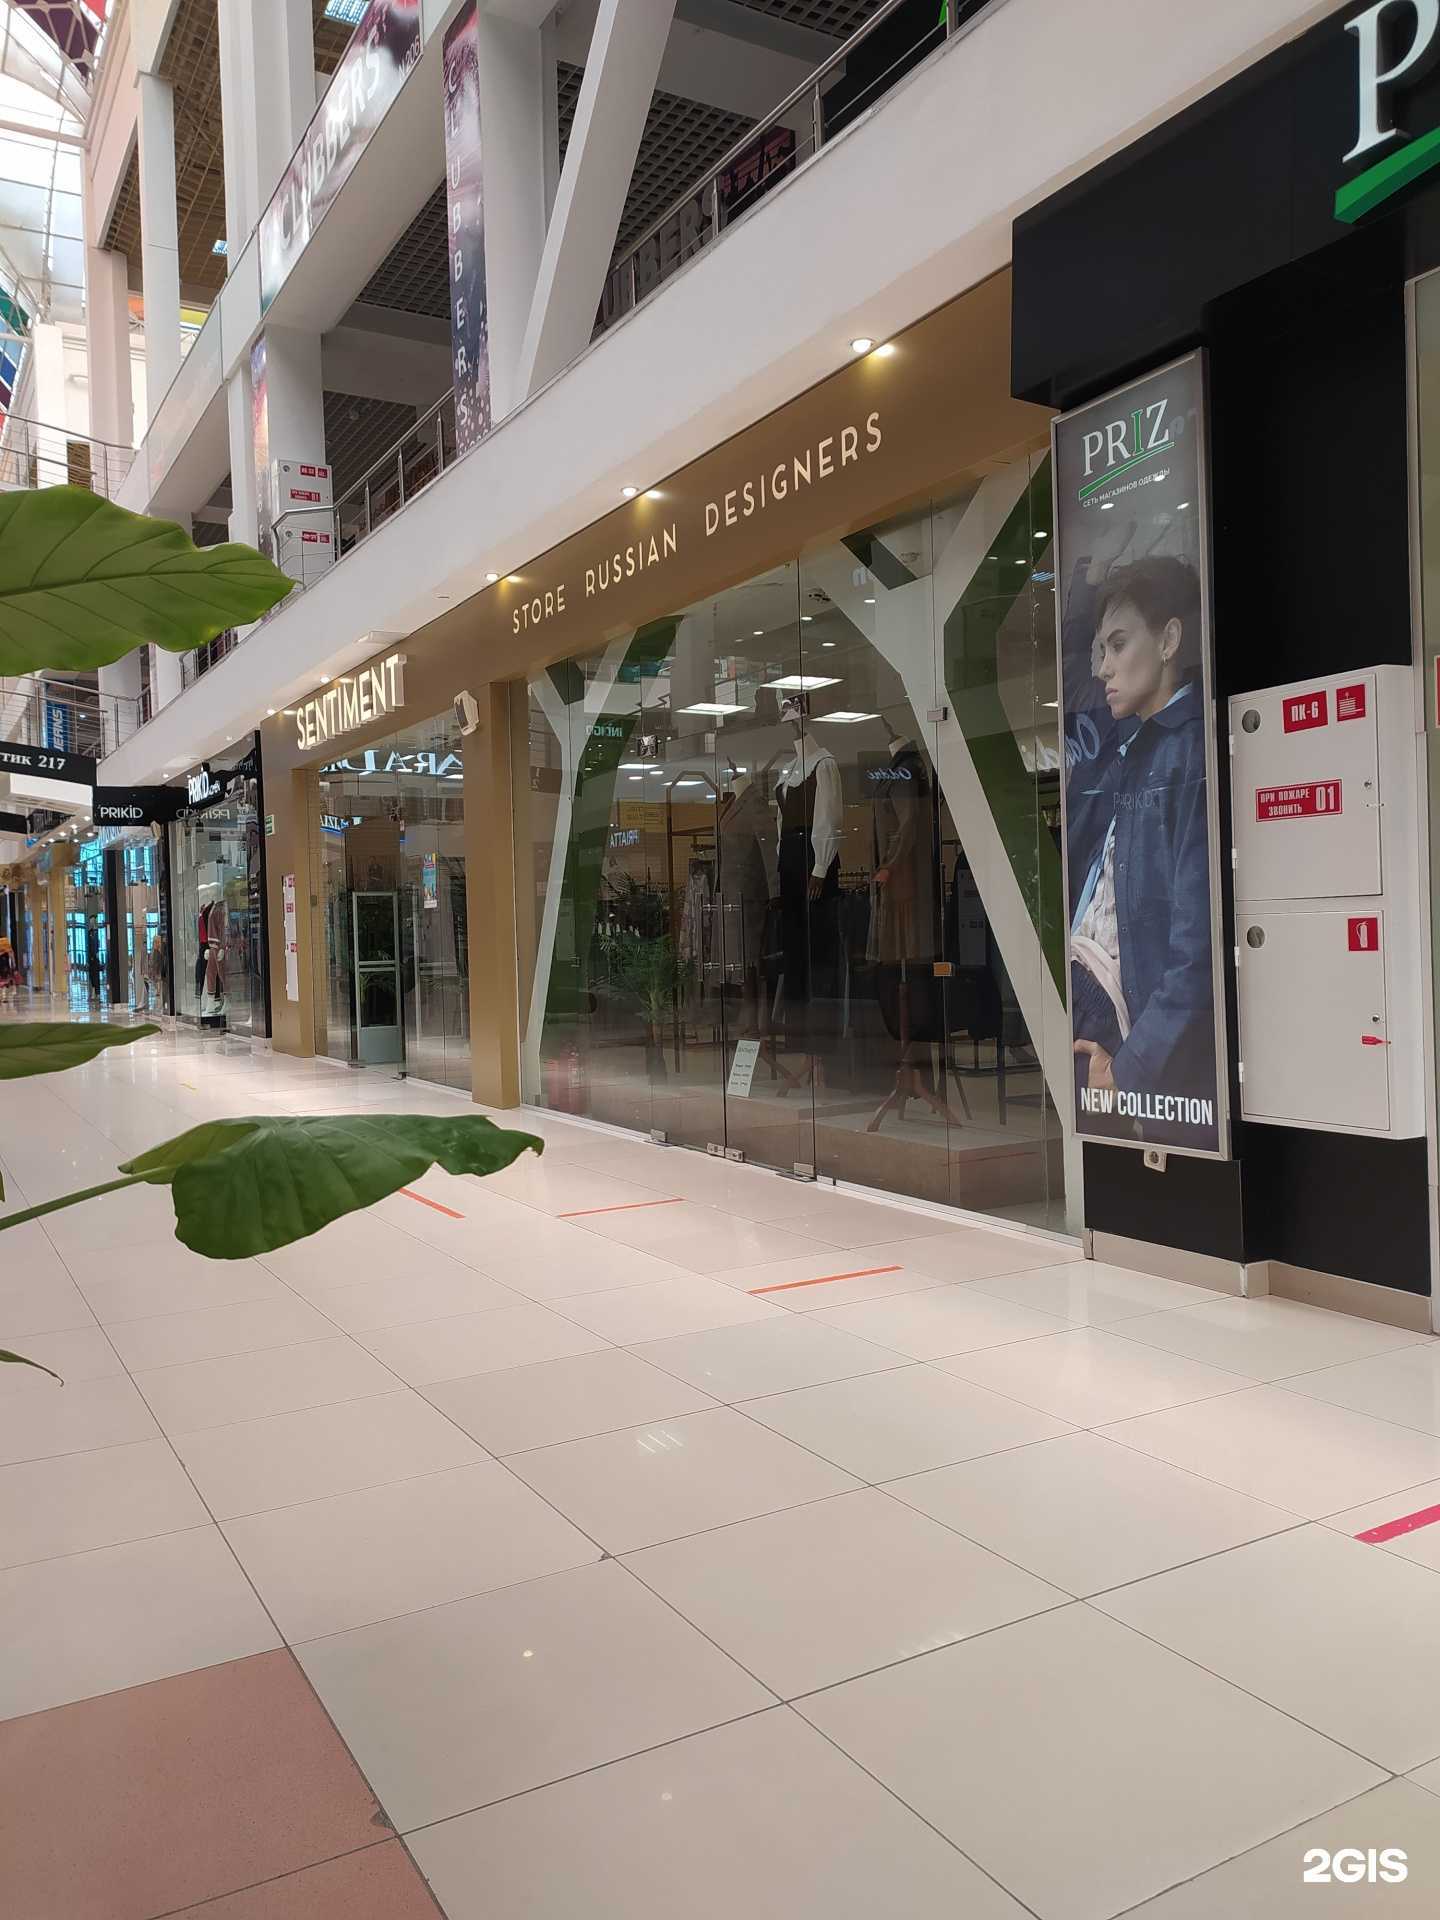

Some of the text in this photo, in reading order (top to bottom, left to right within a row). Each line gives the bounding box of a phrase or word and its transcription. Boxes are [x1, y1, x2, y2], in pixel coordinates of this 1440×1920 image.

[1344, 0, 1439, 162] P
[279, 24, 380, 250] CLUBBERS
[447, 62, 469, 425] CLUBBERS
[1082, 399, 1169, 476] PRIZ
[1083, 497, 1099, 507] СЕТЬ
[1099, 480, 1138, 500] МАГАЗИНОВ
[513, 411, 882, 634] STORE RUSSIAN DESIGNERS
[296, 653, 406, 751] SENTIMENT
[1291, 701, 1319, 723] ПК-6
[37, 755, 66, 770] 217
[1260, 788, 1310, 803] ПРИ ПОЖАРЕ
[1268, 804, 1303, 817] ЗВОНИТЬ
[1316, 785, 1335, 811] 01
[1081, 1087, 1213, 1126] NEW COLLECTION
